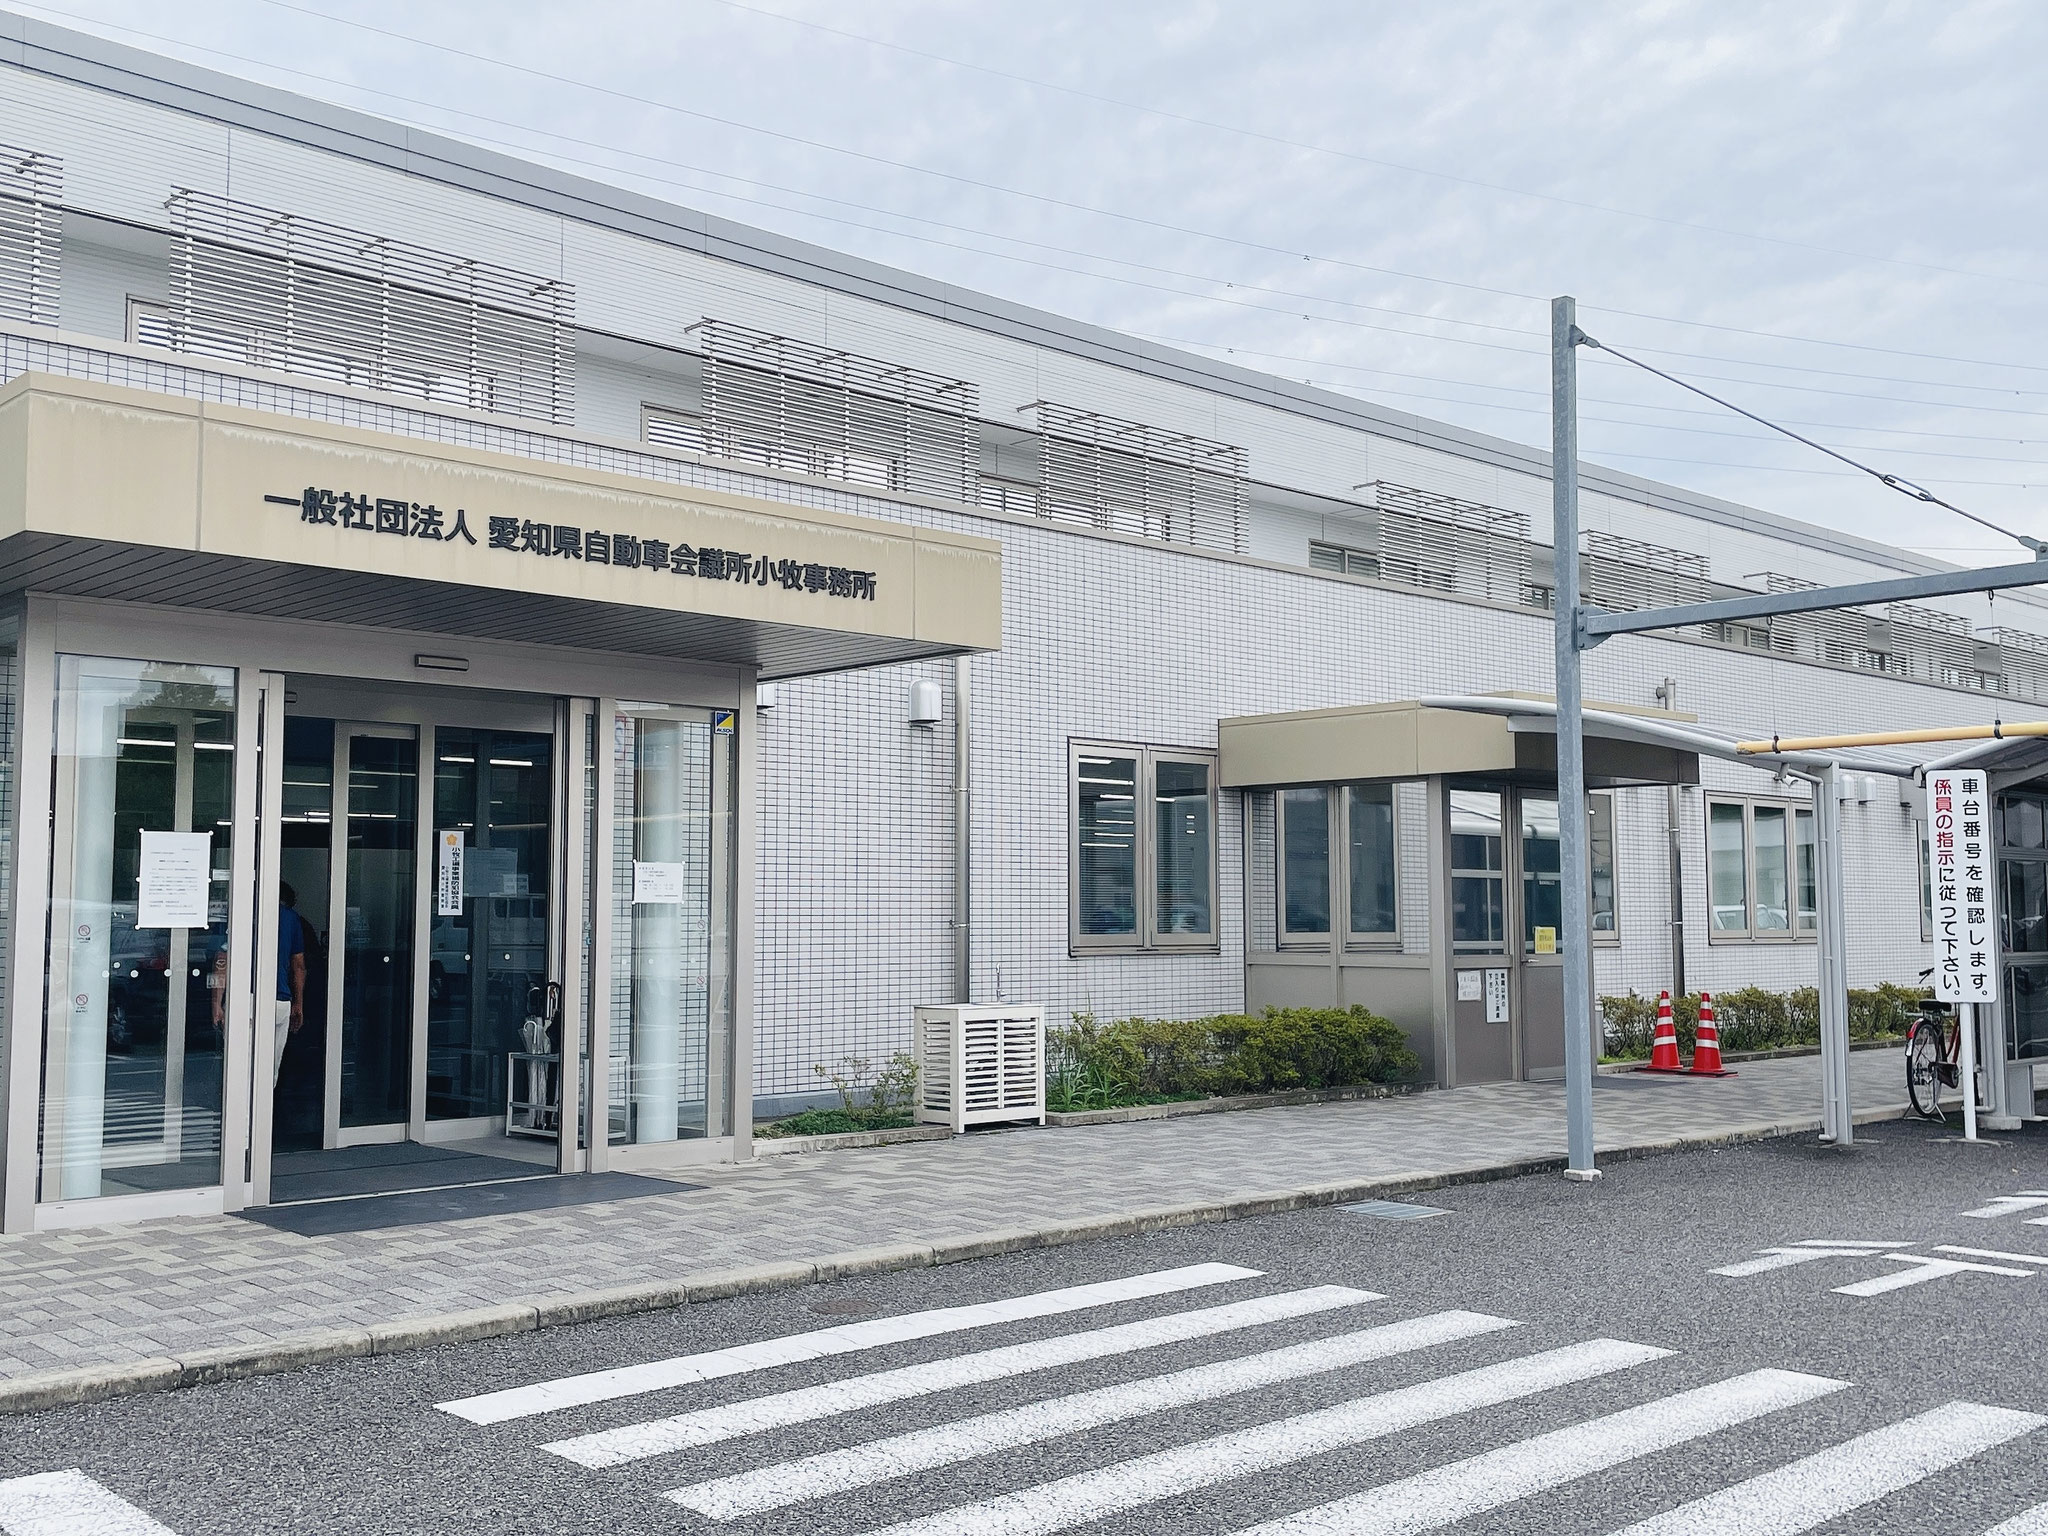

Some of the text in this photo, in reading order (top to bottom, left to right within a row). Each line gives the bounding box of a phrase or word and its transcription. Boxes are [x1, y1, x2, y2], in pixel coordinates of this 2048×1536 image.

[264, 487, 877, 601] 一般社団法人 愛知県自動車会議所小牧事務所
[1961, 778, 1988, 996] 車台番号を確認します。
